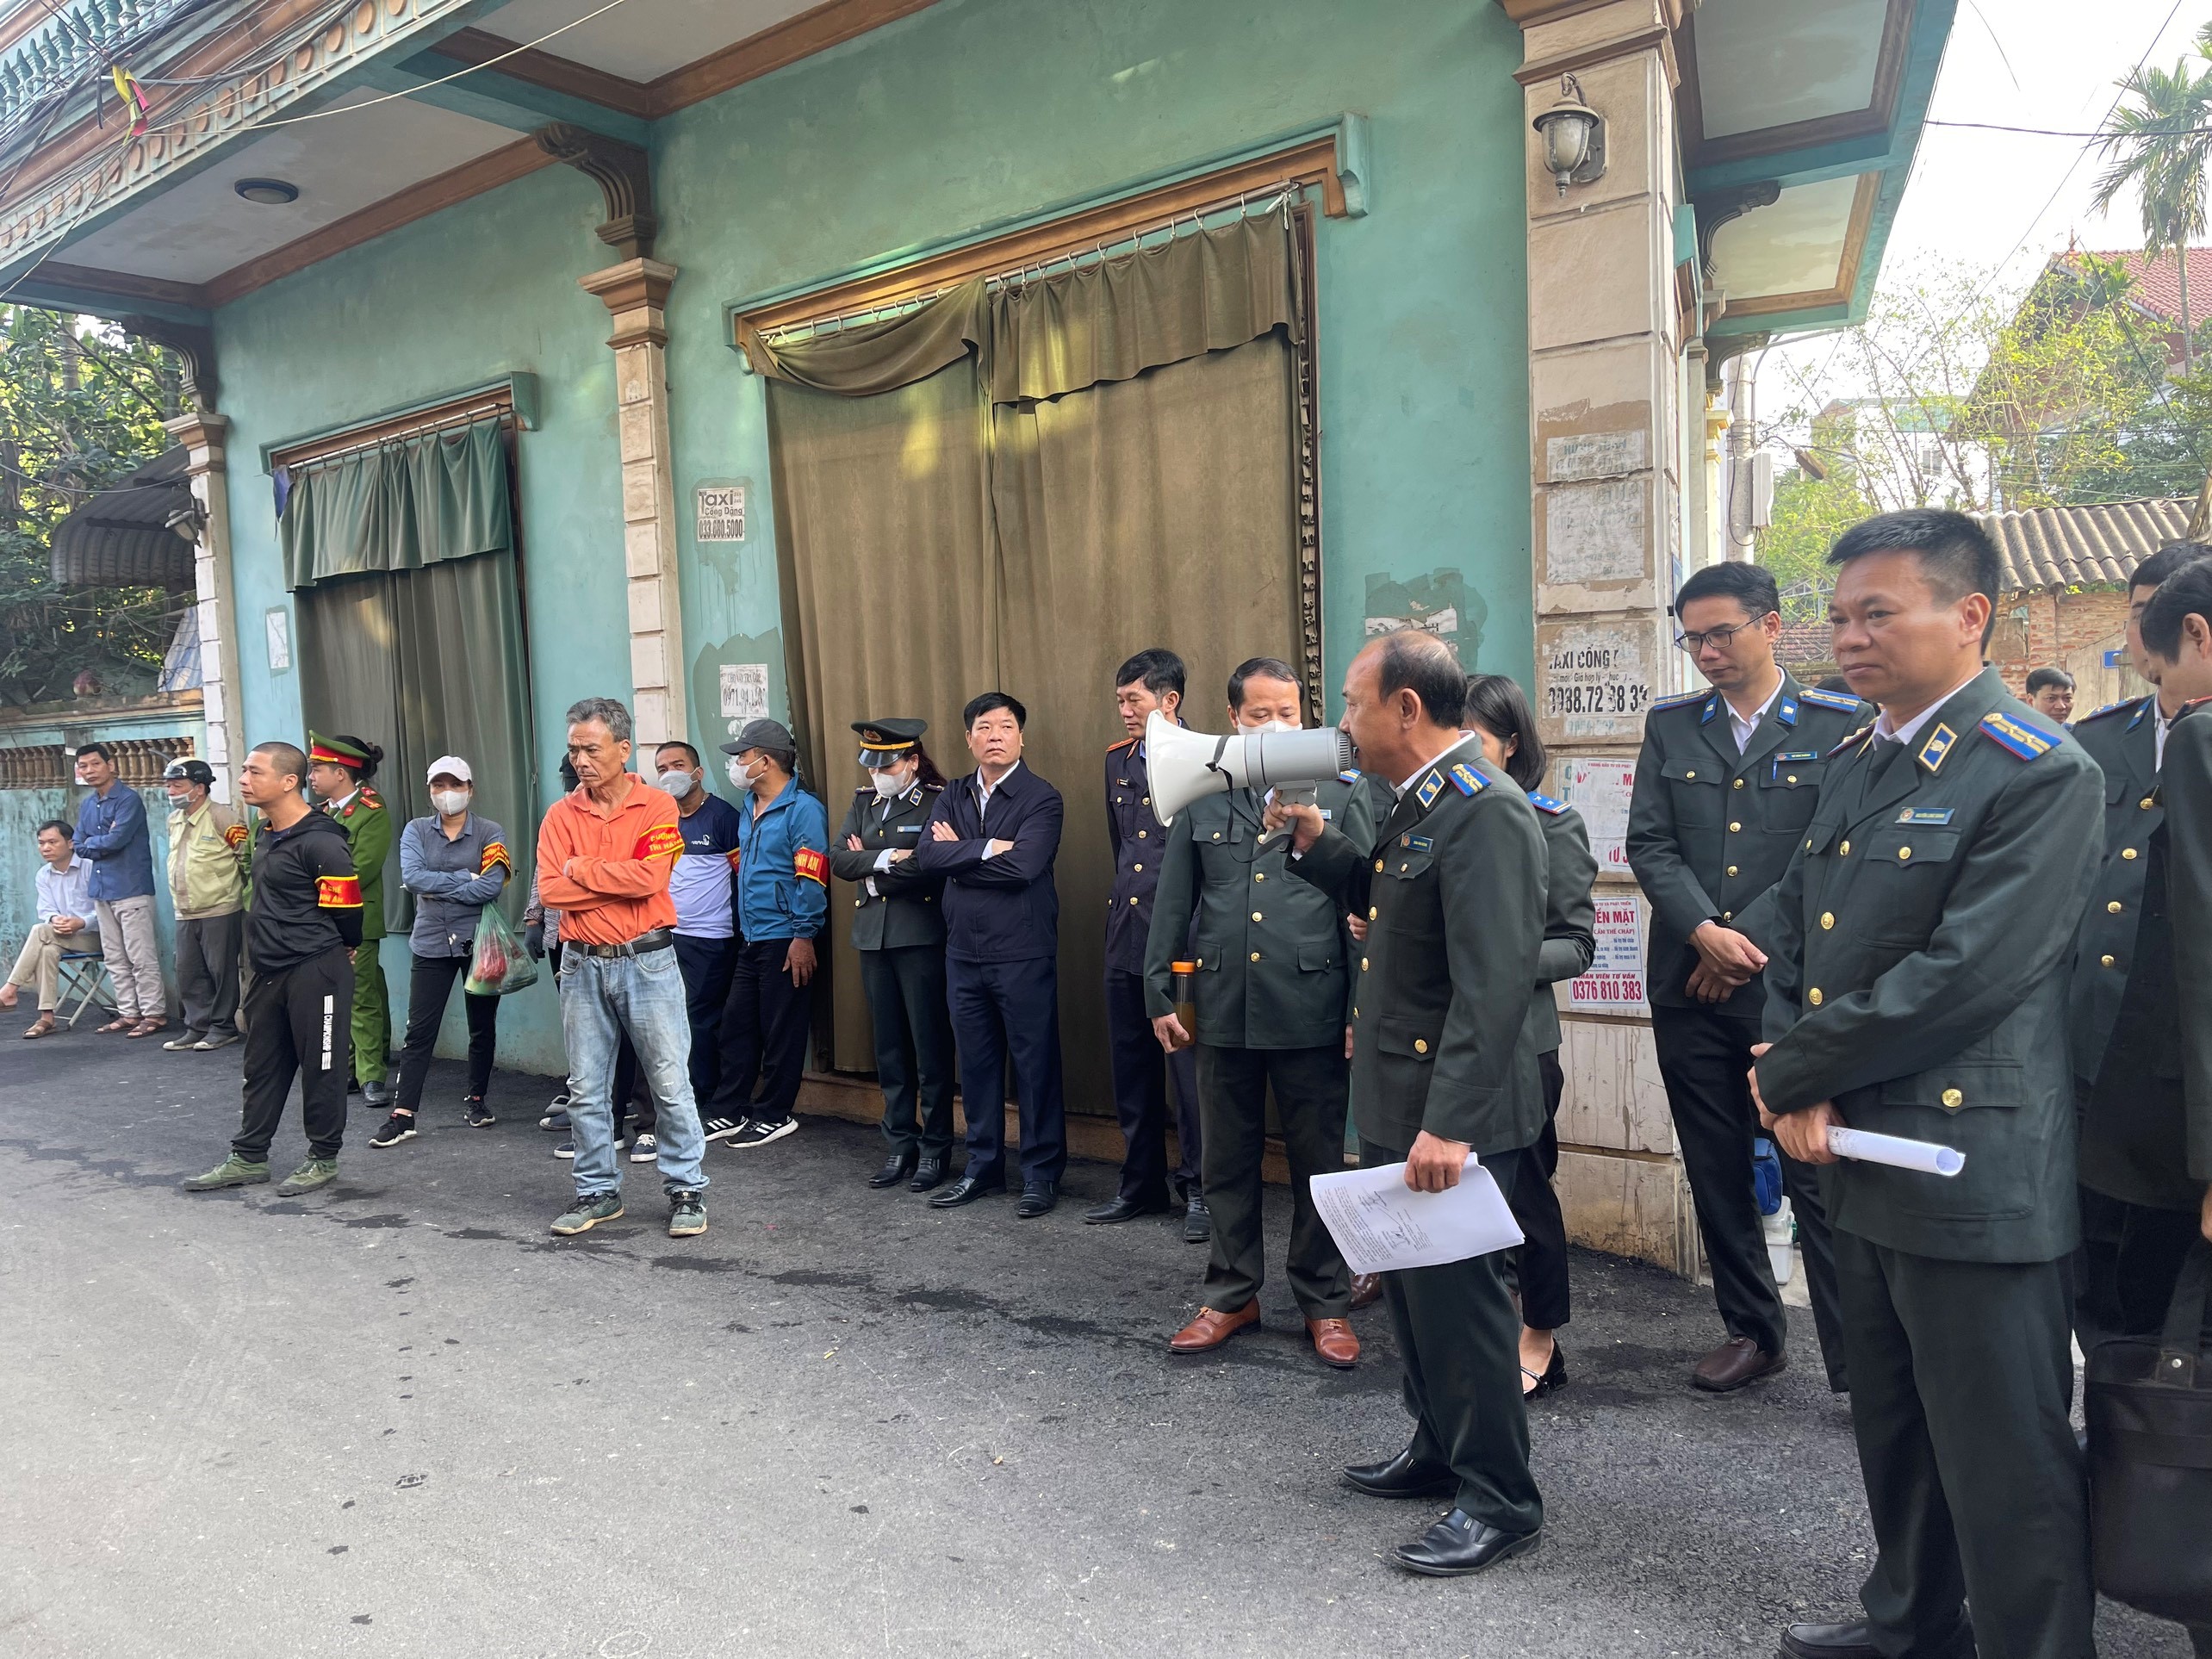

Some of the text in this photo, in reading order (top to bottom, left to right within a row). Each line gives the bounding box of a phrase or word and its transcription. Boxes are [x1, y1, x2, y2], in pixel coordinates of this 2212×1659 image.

[699, 490, 733, 514] Taxi
[1550, 651, 1574, 669] AXI
[1577, 643, 1610, 669] CỐNG
[1612, 908, 1635, 926] MẶT
[1573, 980, 1642, 1000] 0376 810 383
